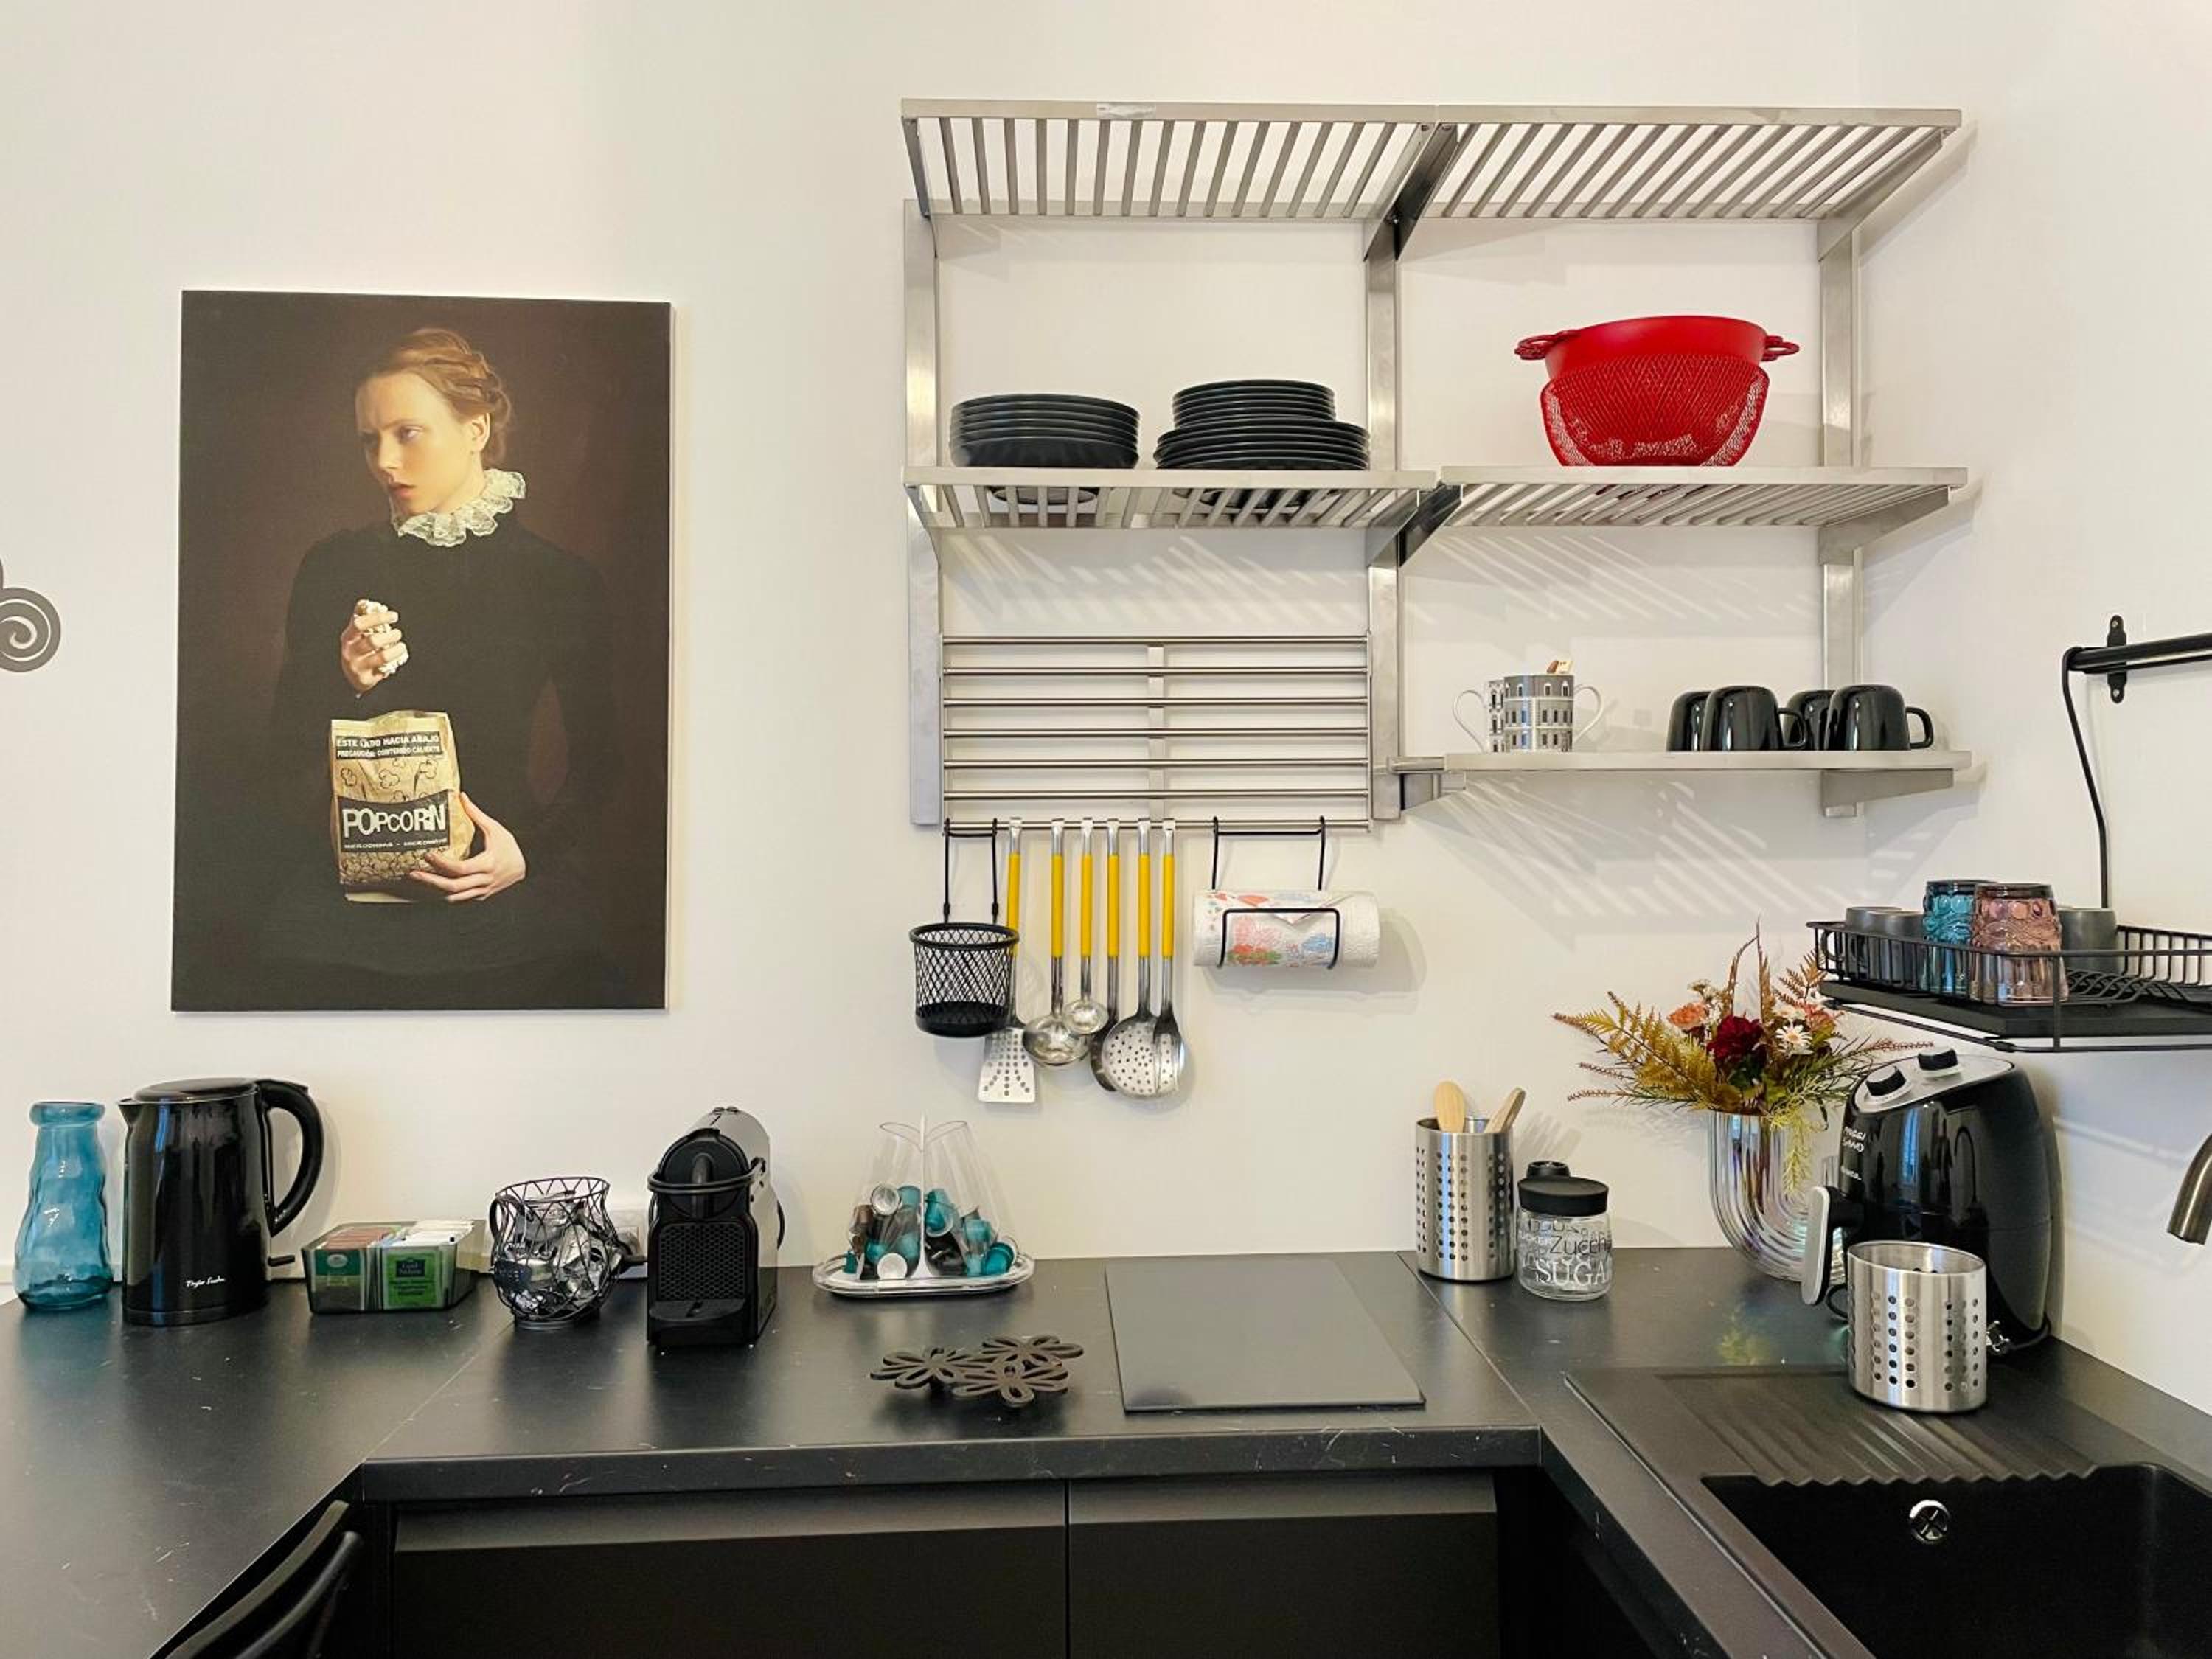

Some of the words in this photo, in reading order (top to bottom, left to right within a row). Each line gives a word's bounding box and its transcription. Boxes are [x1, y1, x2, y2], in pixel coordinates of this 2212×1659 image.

[337, 738, 358, 747] ESTE
[359, 738, 381, 748] LADO
[383, 735, 409, 745] HACIA
[411, 734, 439, 743] ABAJO
[341, 803, 447, 838] POPCORN
[1535, 1258, 1610, 1286] SUGA
